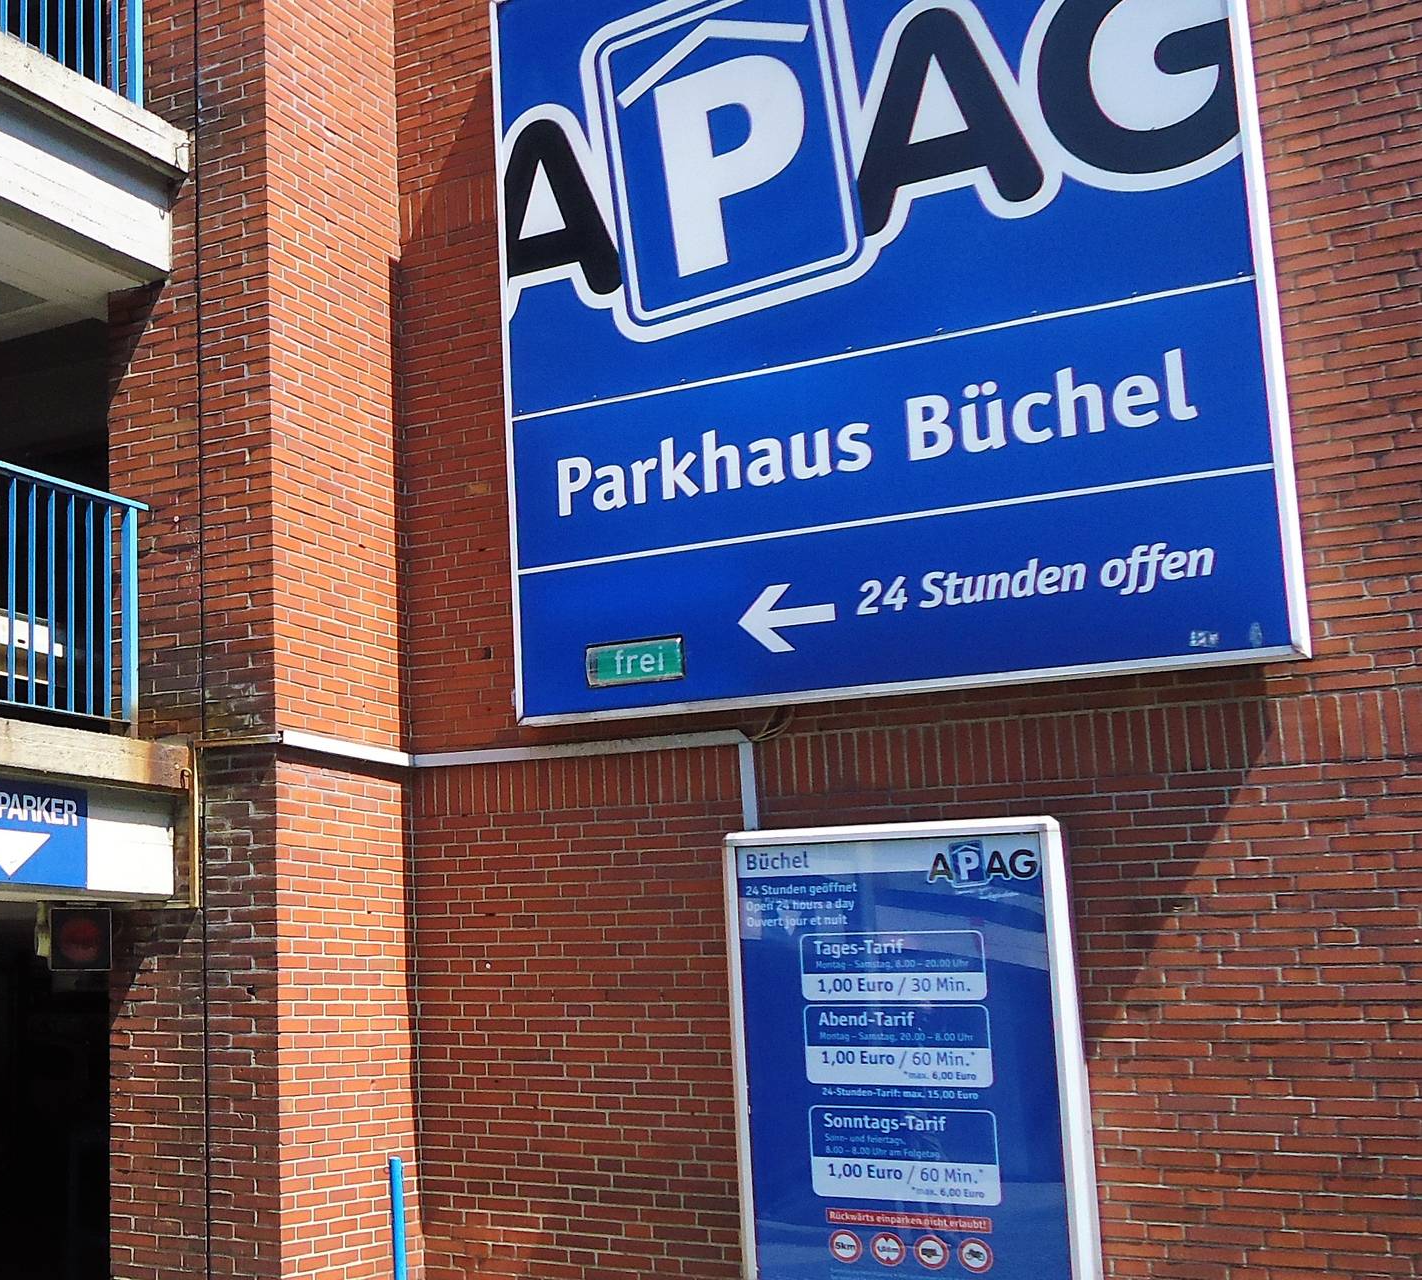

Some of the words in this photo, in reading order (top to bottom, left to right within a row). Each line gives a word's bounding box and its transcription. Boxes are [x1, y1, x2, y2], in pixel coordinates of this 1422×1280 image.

[503, 0, 1239, 297] APAG
[556, 416, 872, 517] Parkhaus
[905, 348, 1198, 462] Büchel
[855, 576, 908, 617] 24
[921, 557, 1087, 610] Stunden
[1100, 542, 1216, 594] offen
[613, 644, 665, 676] frei
[746, 850, 809, 871] Büchel
[928, 848, 1037, 881] APAG
[746, 885, 759, 896] 24
[762, 883, 807, 895] Stunden
[809, 881, 858, 897] geöffnet
[746, 901, 774, 914] Open
[776, 900, 790, 911] 24
[792, 899, 823, 910] hours
[825, 901, 833, 909] a
[835, 898, 855, 911] day
[746, 916, 783, 928] Ouvert
[784, 916, 808, 929] jour
[810, 915, 822, 926] et
[823, 914, 848, 925] nuit
[813, 938, 905, 959] Tages-Tarif
[816, 960, 846, 971] Montag
[952, 958, 970, 969] Uhr
[818, 978, 853, 995] 1,00
[858, 977, 894, 992] Euro
[897, 977, 907, 996] /
[911, 977, 931, 993] 30
[936, 976, 971, 992] Min.
[818, 1011, 916, 1027] Abend-Tarif
[820, 1031, 850, 1042] Montag
[899, 1032, 926, 1041] 20.00
[957, 1033, 973, 1042] Uhr
[821, 1050, 855, 1067] 1,00
[860, 1050, 895, 1066] Euro
[898, 1050, 907, 1069] /
[911, 1051, 932, 1066] 60
[931, 1071, 954, 1081] 6,00
[955, 1071, 977, 1081] Euro
[822, 1087, 901, 1098] 24-Stunden-Tarif:
[903, 1090, 925, 1098] max.
[927, 1089, 955, 1100] 15,00
[957, 1091, 979, 1100] Euro
[823, 1112, 947, 1134] Sonntags-Tarif
[849, 1134, 865, 1143] und
[871, 1146, 887, 1156] Uhr
[888, 1149, 902, 1157] am
[903, 1148, 941, 1161] Folgetag
[828, 1163, 863, 1179] 1,00
[867, 1164, 903, 1180] Euro
[906, 1165, 915, 1185] /
[920, 1167, 939, 1182] 60
[939, 1188, 962, 1200] 6,00
[963, 1189, 985, 1199] Euro
[829, 1210, 875, 1223] Rückwärts
[876, 1213, 924, 1228] einparken
[924, 1216, 948, 1227] nicht
[949, 1218, 987, 1230] erlaubt!
[834, 1240, 856, 1251] 5km
